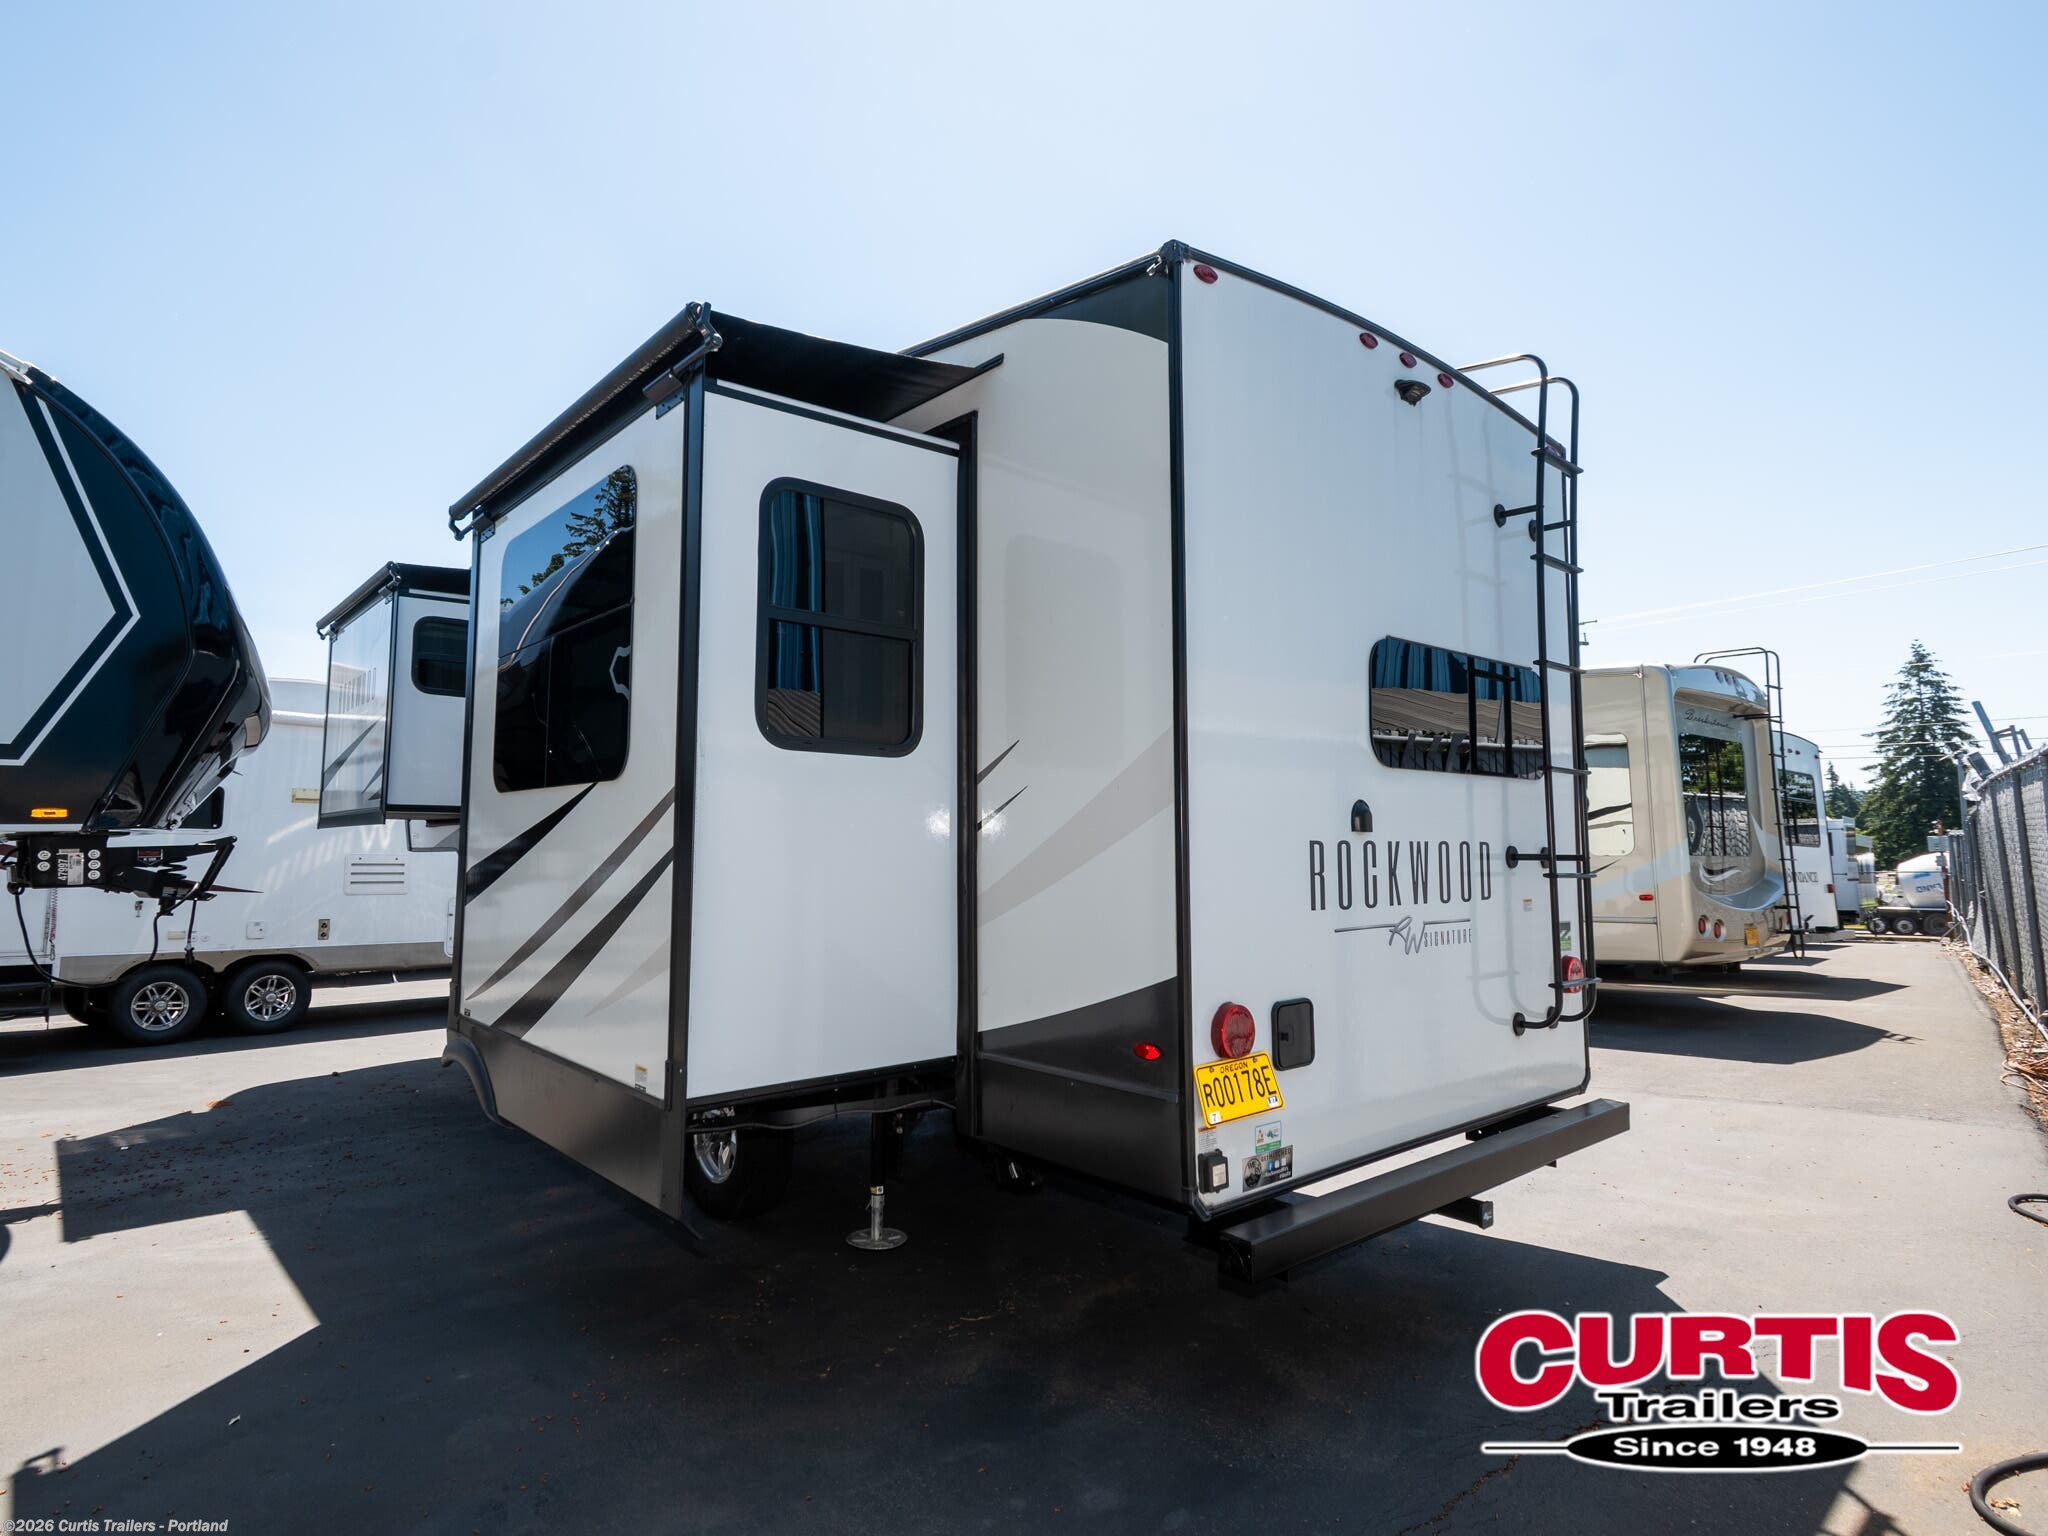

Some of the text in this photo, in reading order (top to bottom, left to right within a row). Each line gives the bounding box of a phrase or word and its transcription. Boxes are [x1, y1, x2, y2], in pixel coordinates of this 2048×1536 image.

[1309, 839, 1492, 911] ROCKWOOD
[1423, 928, 1472, 948] SIGNATURE
[1220, 1061, 1249, 1074] OREGON
